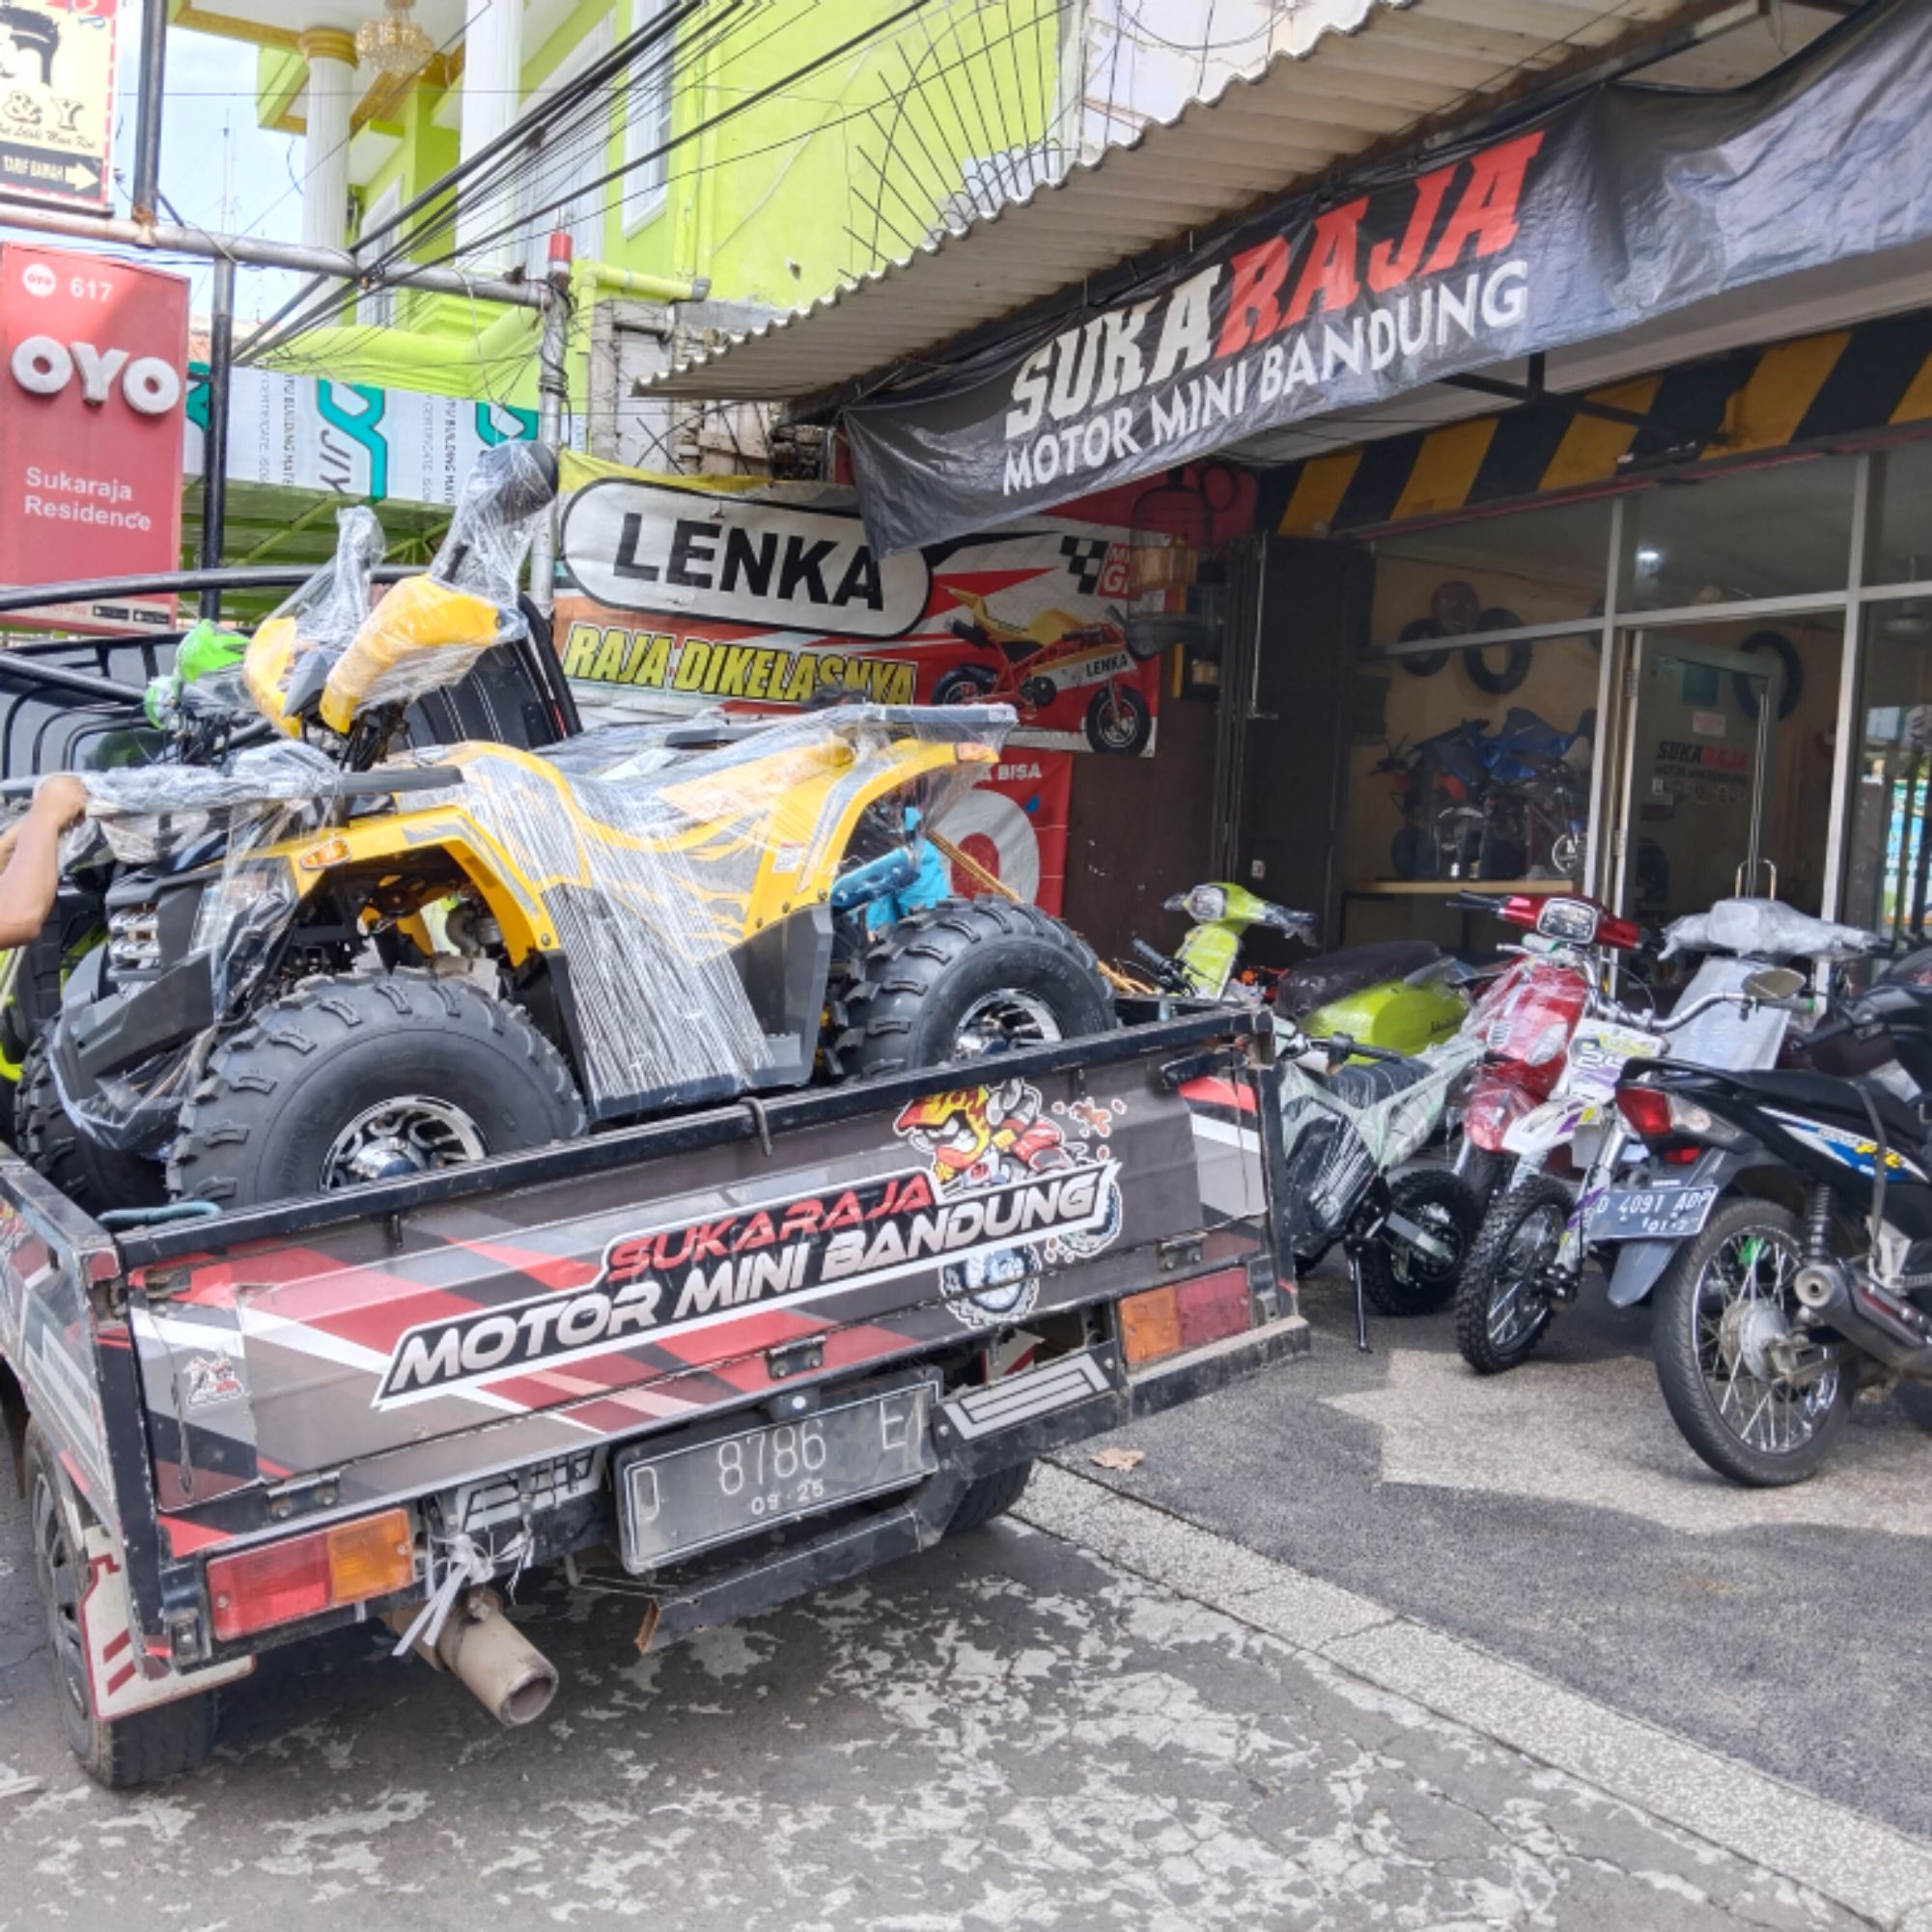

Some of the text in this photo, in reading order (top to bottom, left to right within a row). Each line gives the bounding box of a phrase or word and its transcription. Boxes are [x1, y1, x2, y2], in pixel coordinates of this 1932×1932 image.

[70, 277, 114, 302] 617
[1005, 130, 1544, 439] SUKARAJA
[12, 335, 181, 415] OYO
[1002, 260, 1528, 496] MOTOR MINI BANDUNG
[24, 494, 152, 532] Residence
[26, 466, 133, 503] Sukaraja
[613, 512, 885, 612] LENKA
[562, 624, 674, 688] RAJA
[997, 763, 1043, 781] BISA
[606, 1172, 934, 1283] SUKARAJA
[389, 1171, 1101, 1392] MOTOR MINI BANDUNG
[631, 1466, 660, 1523] D
[716, 1417, 826, 1496] 8786
